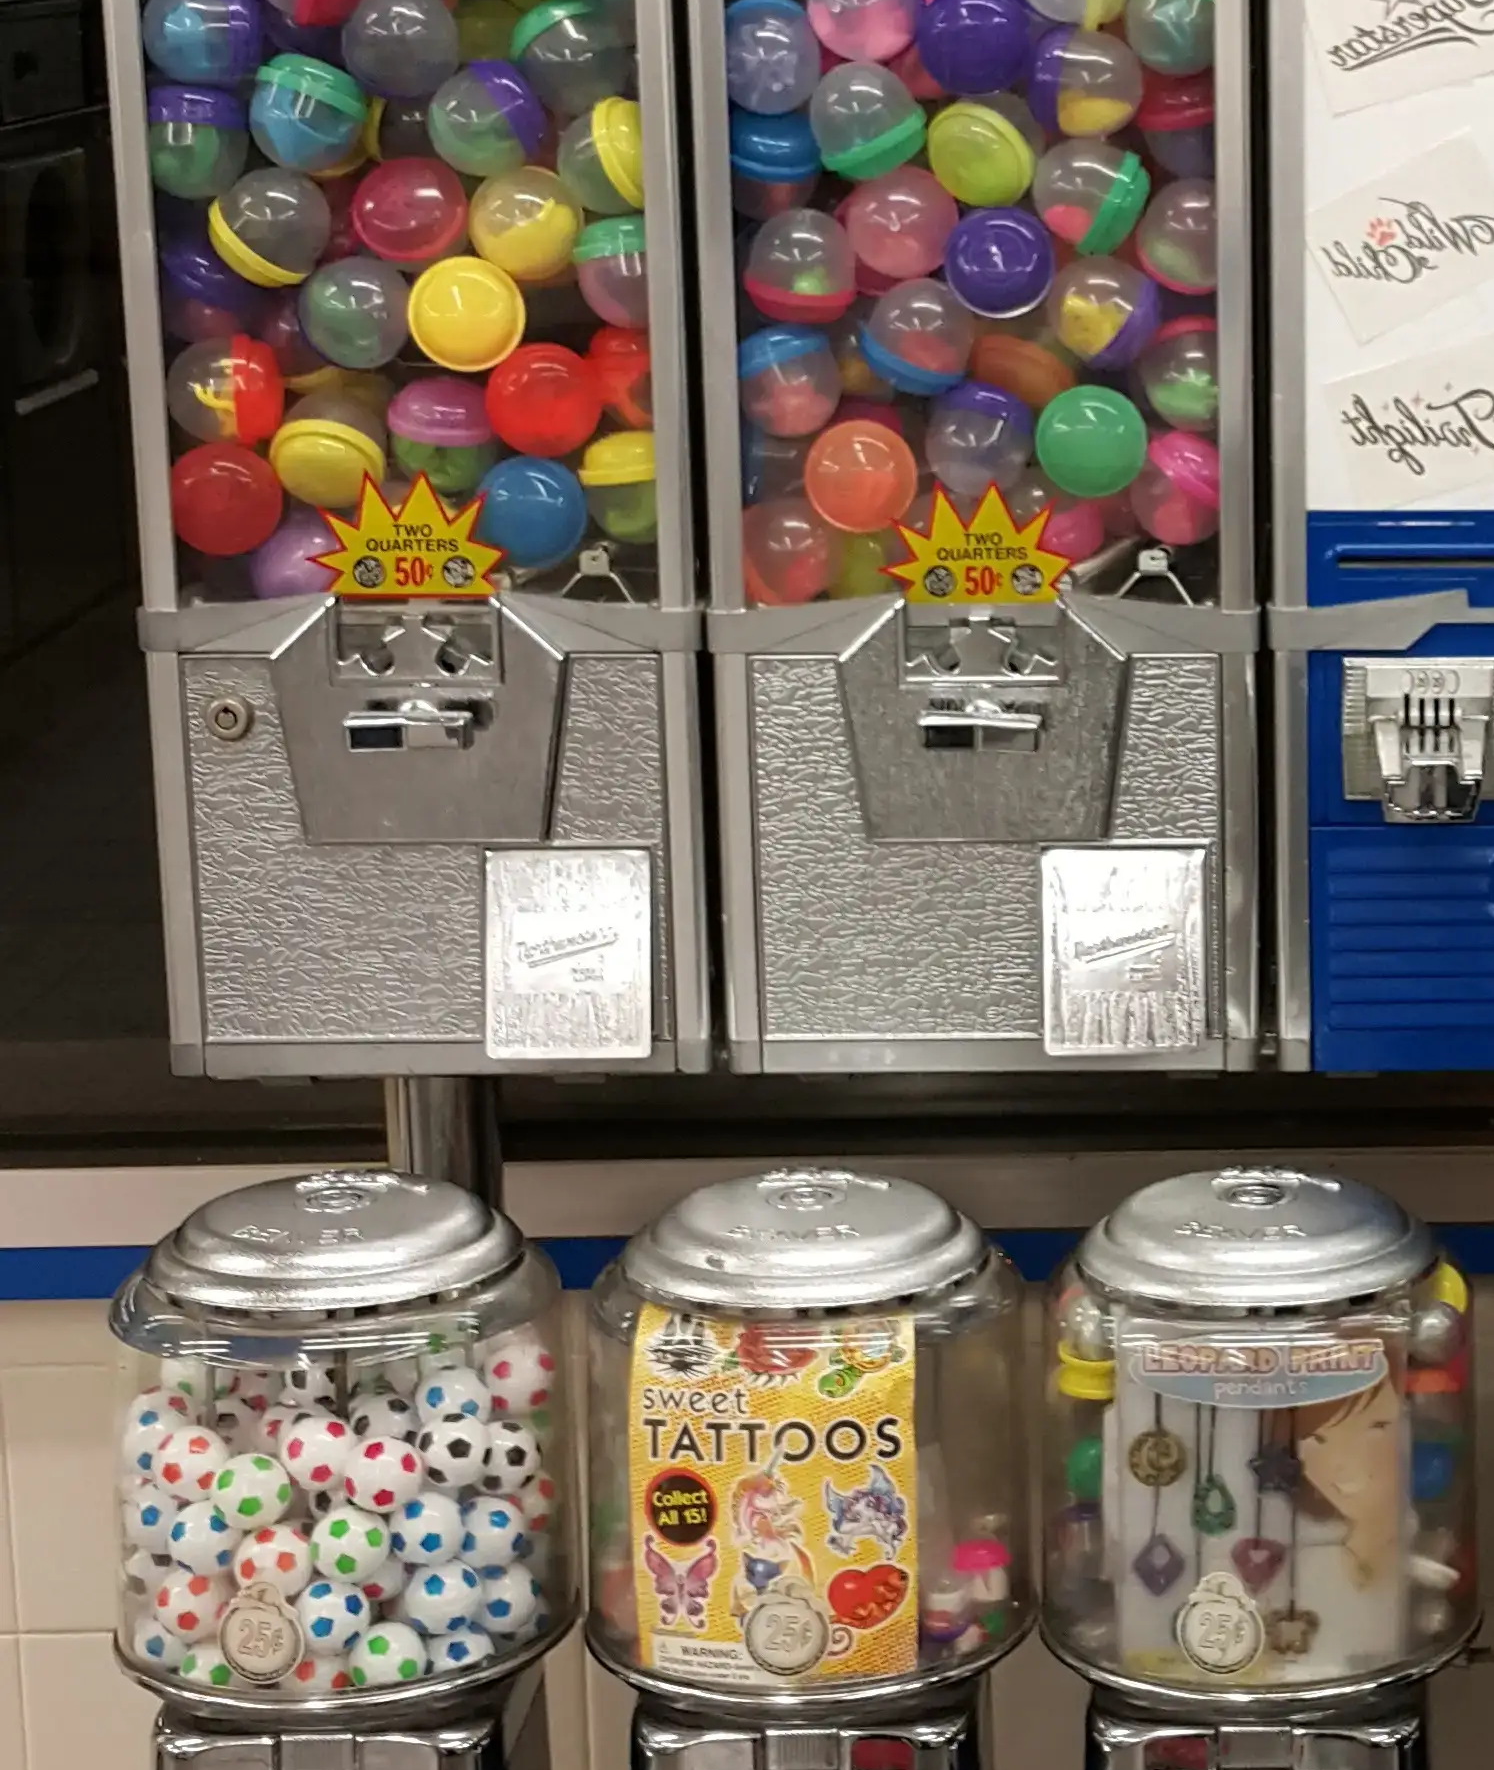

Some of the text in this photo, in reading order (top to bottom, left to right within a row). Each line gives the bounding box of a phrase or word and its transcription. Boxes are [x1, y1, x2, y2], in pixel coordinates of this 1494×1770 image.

[392, 523, 433, 538] TWO
[366, 538, 460, 552] QUARTERS
[964, 532, 1004, 547] TWO
[936, 546, 1029, 561] QUARTERS
[1213, 1379, 1309, 1401] pendants
[643, 1387, 748, 1415] sweet
[643, 1417, 902, 1463] TATTOOS
[653, 1491, 709, 1507] Collect
[658, 1509, 709, 1526] All 15!
